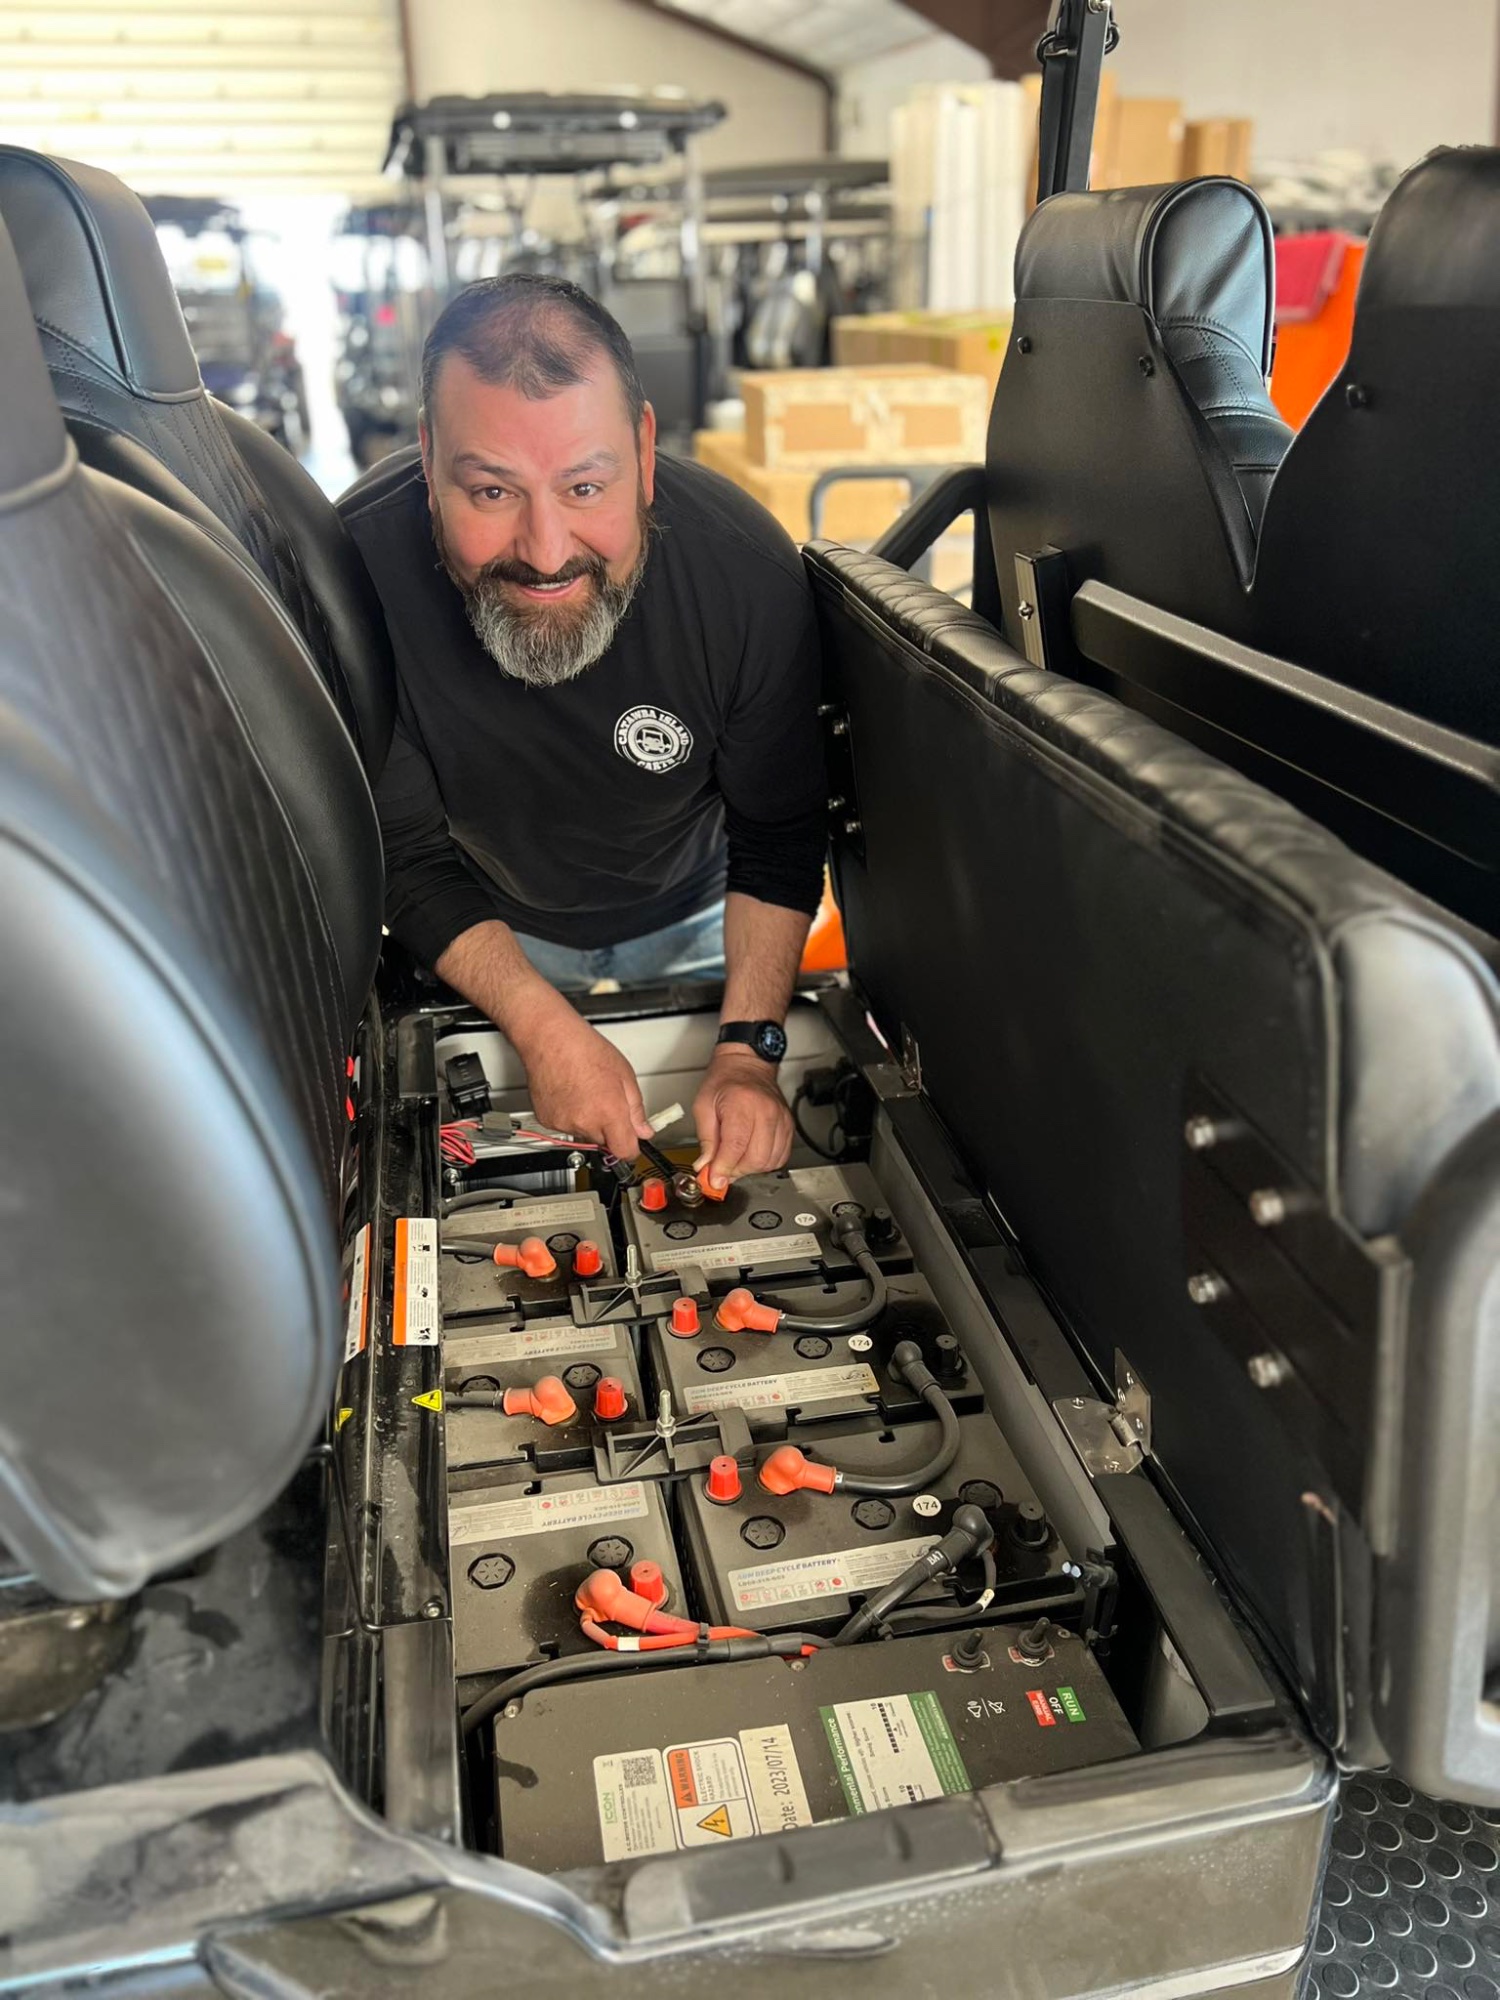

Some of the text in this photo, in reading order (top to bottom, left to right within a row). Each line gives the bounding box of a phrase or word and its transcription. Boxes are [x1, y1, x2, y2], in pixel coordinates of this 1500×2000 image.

[619, 709, 689, 745] CATAWBA ISLAND
[637, 758, 675, 770] CARTS
[852, 1339, 869, 1348] 174
[747, 1379, 778, 1387] BATTERY
[917, 1501, 938, 1511] 174
[541, 1515, 578, 1527] BATTERY
[776, 1564, 801, 1573] CYCLE
[802, 1558, 837, 1568] BATTERY
[1036, 1692, 1053, 1721] MANUAL
[1049, 1697, 1064, 1715] OFF
[1062, 1692, 1079, 1716] RUN
[826, 1718, 851, 1772] Performance
[675, 1752, 689, 1791] WARNING
[692, 1750, 707, 1802] ELECTRIC SHOCK
[705, 1775, 715, 1800] HAZARD
[762, 1737, 799, 1831] Date: 2023/07/14
[602, 1791, 613, 1824] ICON
